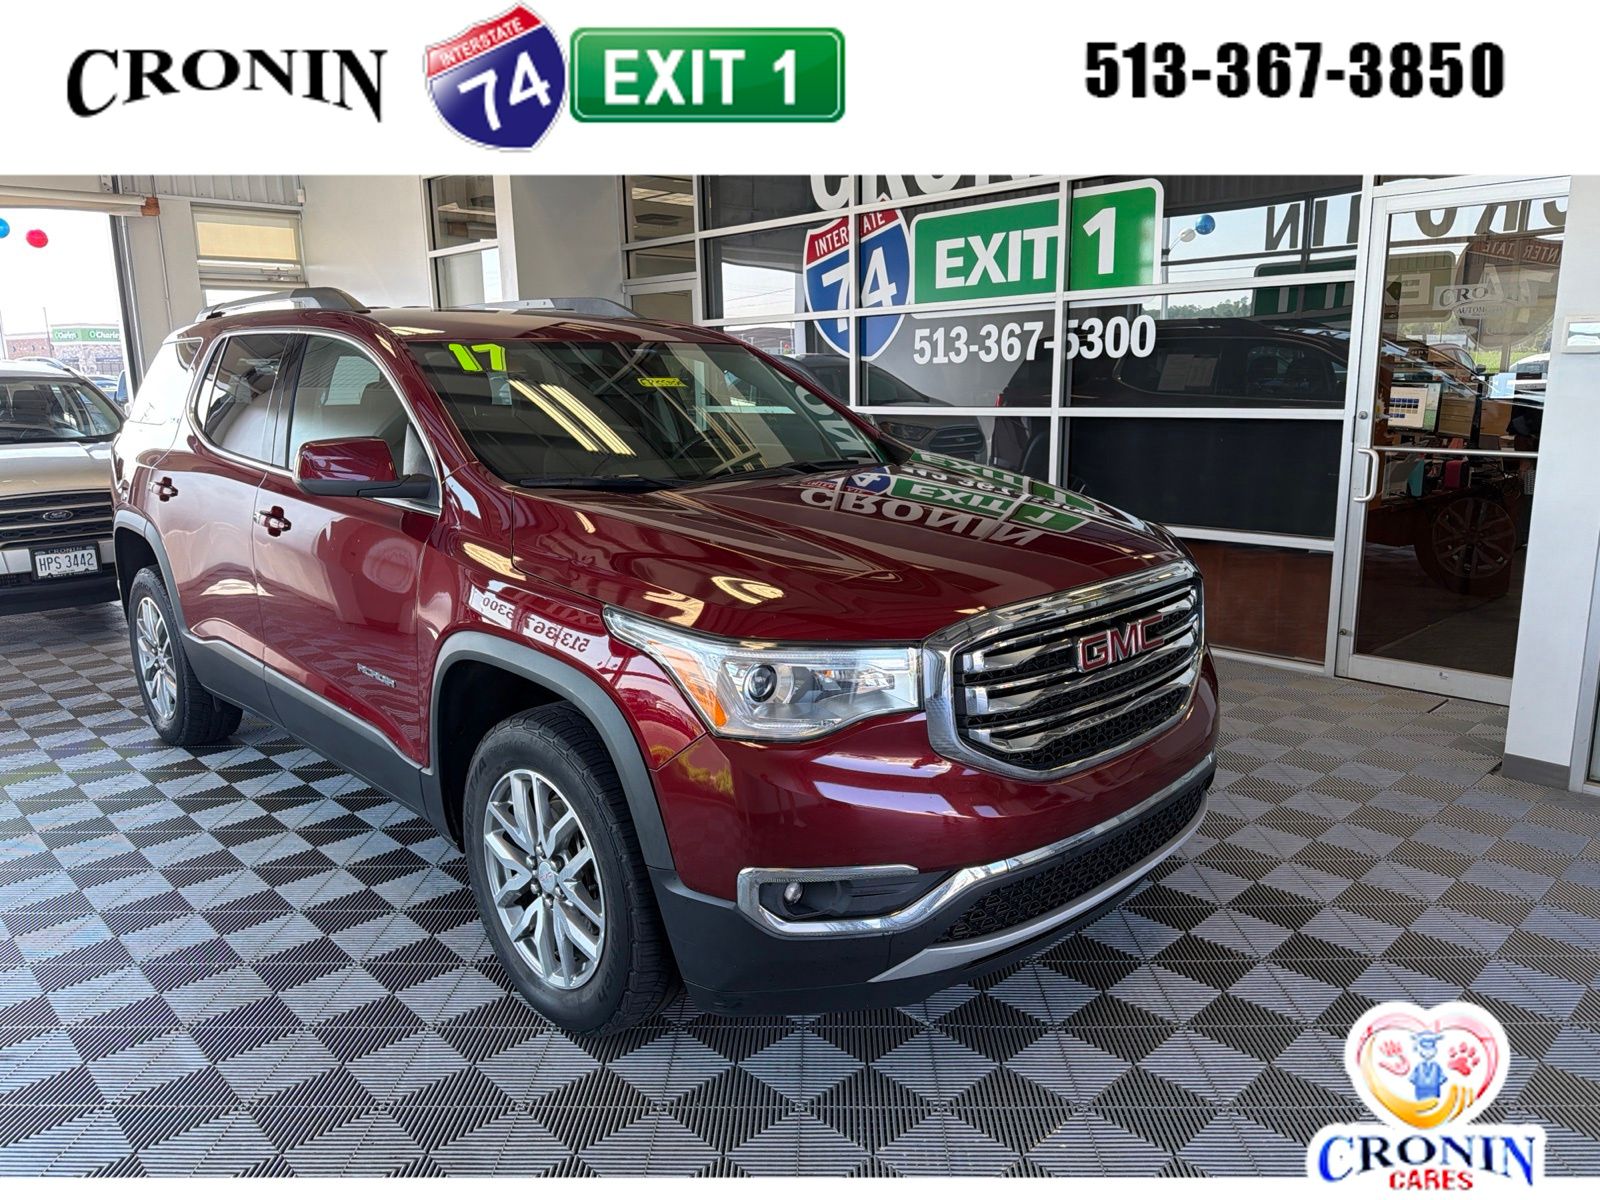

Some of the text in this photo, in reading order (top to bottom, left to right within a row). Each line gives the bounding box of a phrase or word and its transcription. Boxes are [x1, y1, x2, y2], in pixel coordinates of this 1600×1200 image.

[935, 206, 1117, 290] EXIT 1
[822, 247, 898, 333] 74
[448, 343, 507, 371] 17
[914, 314, 1157, 364] 513-367-5300
[39, 552, 94, 572] HPS 3442
[1076, 612, 1167, 673] GMC
